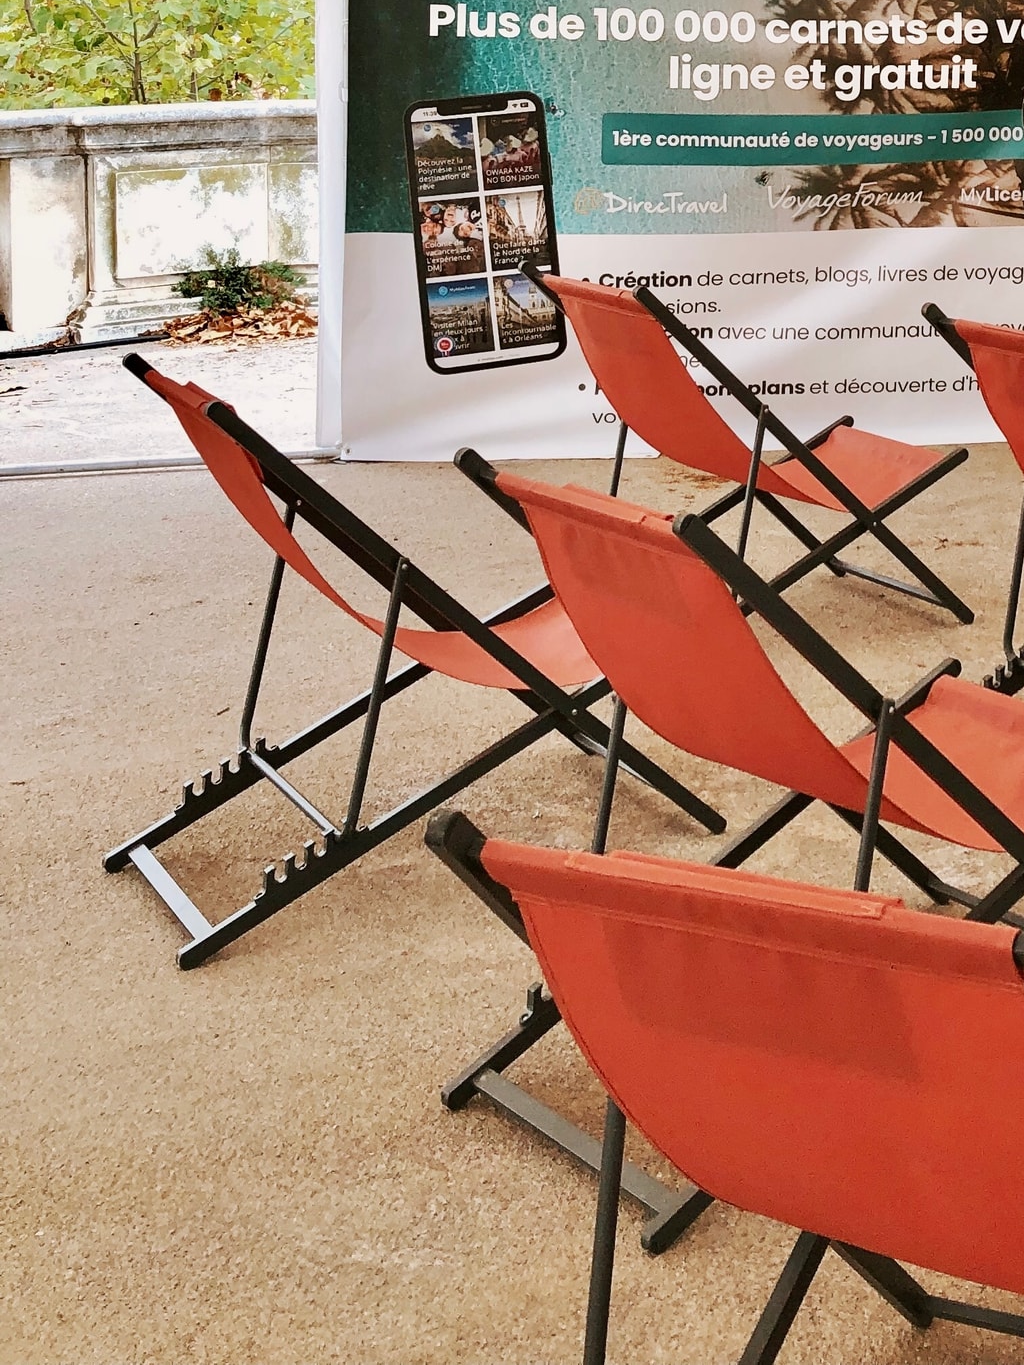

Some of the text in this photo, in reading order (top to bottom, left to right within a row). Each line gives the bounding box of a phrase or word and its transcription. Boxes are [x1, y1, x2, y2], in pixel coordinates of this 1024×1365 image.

[429, 3, 521, 38] Plus
[529, 6, 585, 40] de
[593, 7, 665, 42] 100
[674, 10, 756, 43] 000
[765, 14, 929, 45] carnets
[936, 11, 989, 45] de
[669, 52, 978, 102] ligne et gratuit
[612, 129, 651, 147] 1ère
[656, 131, 790, 148] communauté
[793, 132, 819, 147] de
[823, 132, 924, 151] voyageurs
[941, 130, 948, 144] 1
[951, 128, 985, 143] 500
[988, 126, 1024, 142] 000
[417, 159, 455, 168] Découvrez
[457, 164, 473, 172] une
[418, 173, 460, 183] destination
[486, 176, 499, 184] NO
[500, 175, 517, 183] BON
[602, 191, 728, 214] DirecTravel
[767, 181, 930, 218] VoyageForum
[493, 242, 509, 250] Que
[502, 247, 520, 256] Nord
[494, 256, 519, 265] France
[599, 271, 692, 288] Création
[697, 271, 723, 286] de
[729, 268, 809, 286] carnets,
[814, 266, 873, 287] blogs,
[877, 265, 928, 283] livres
[933, 265, 959, 282] de
[718, 327, 766, 340] avec
[772, 326, 809, 340] une
[814, 324, 941, 340] communaut
[748, 380, 805, 395] plans
[809, 380, 829, 395] et
[834, 377, 947, 394] découverte
